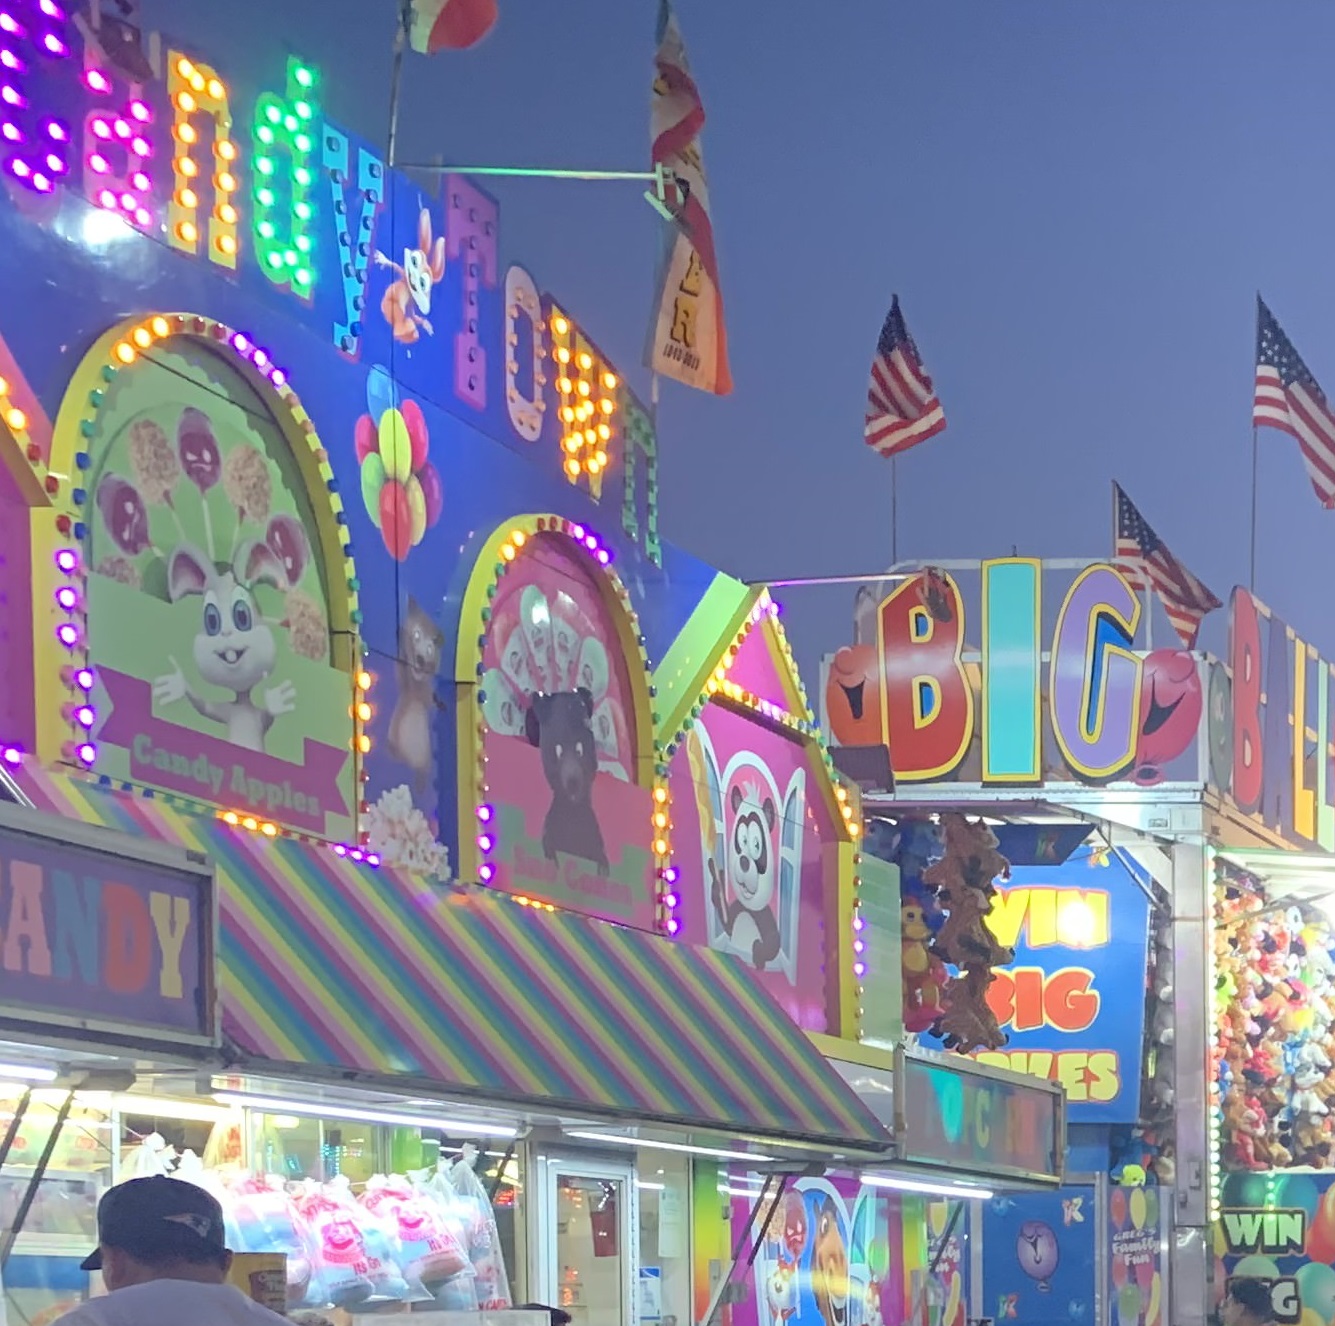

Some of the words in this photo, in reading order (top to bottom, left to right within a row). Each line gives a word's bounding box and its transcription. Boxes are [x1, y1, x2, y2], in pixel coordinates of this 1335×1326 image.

[877, 556, 1143, 782] BIG
[133, 733, 224, 794] Candy
[230, 765, 320, 816] Apples
[0, 858, 190, 998] ANDY
[1123, 1253, 1151, 1266] Fun
[1222, 1211, 1304, 1250] WIN
